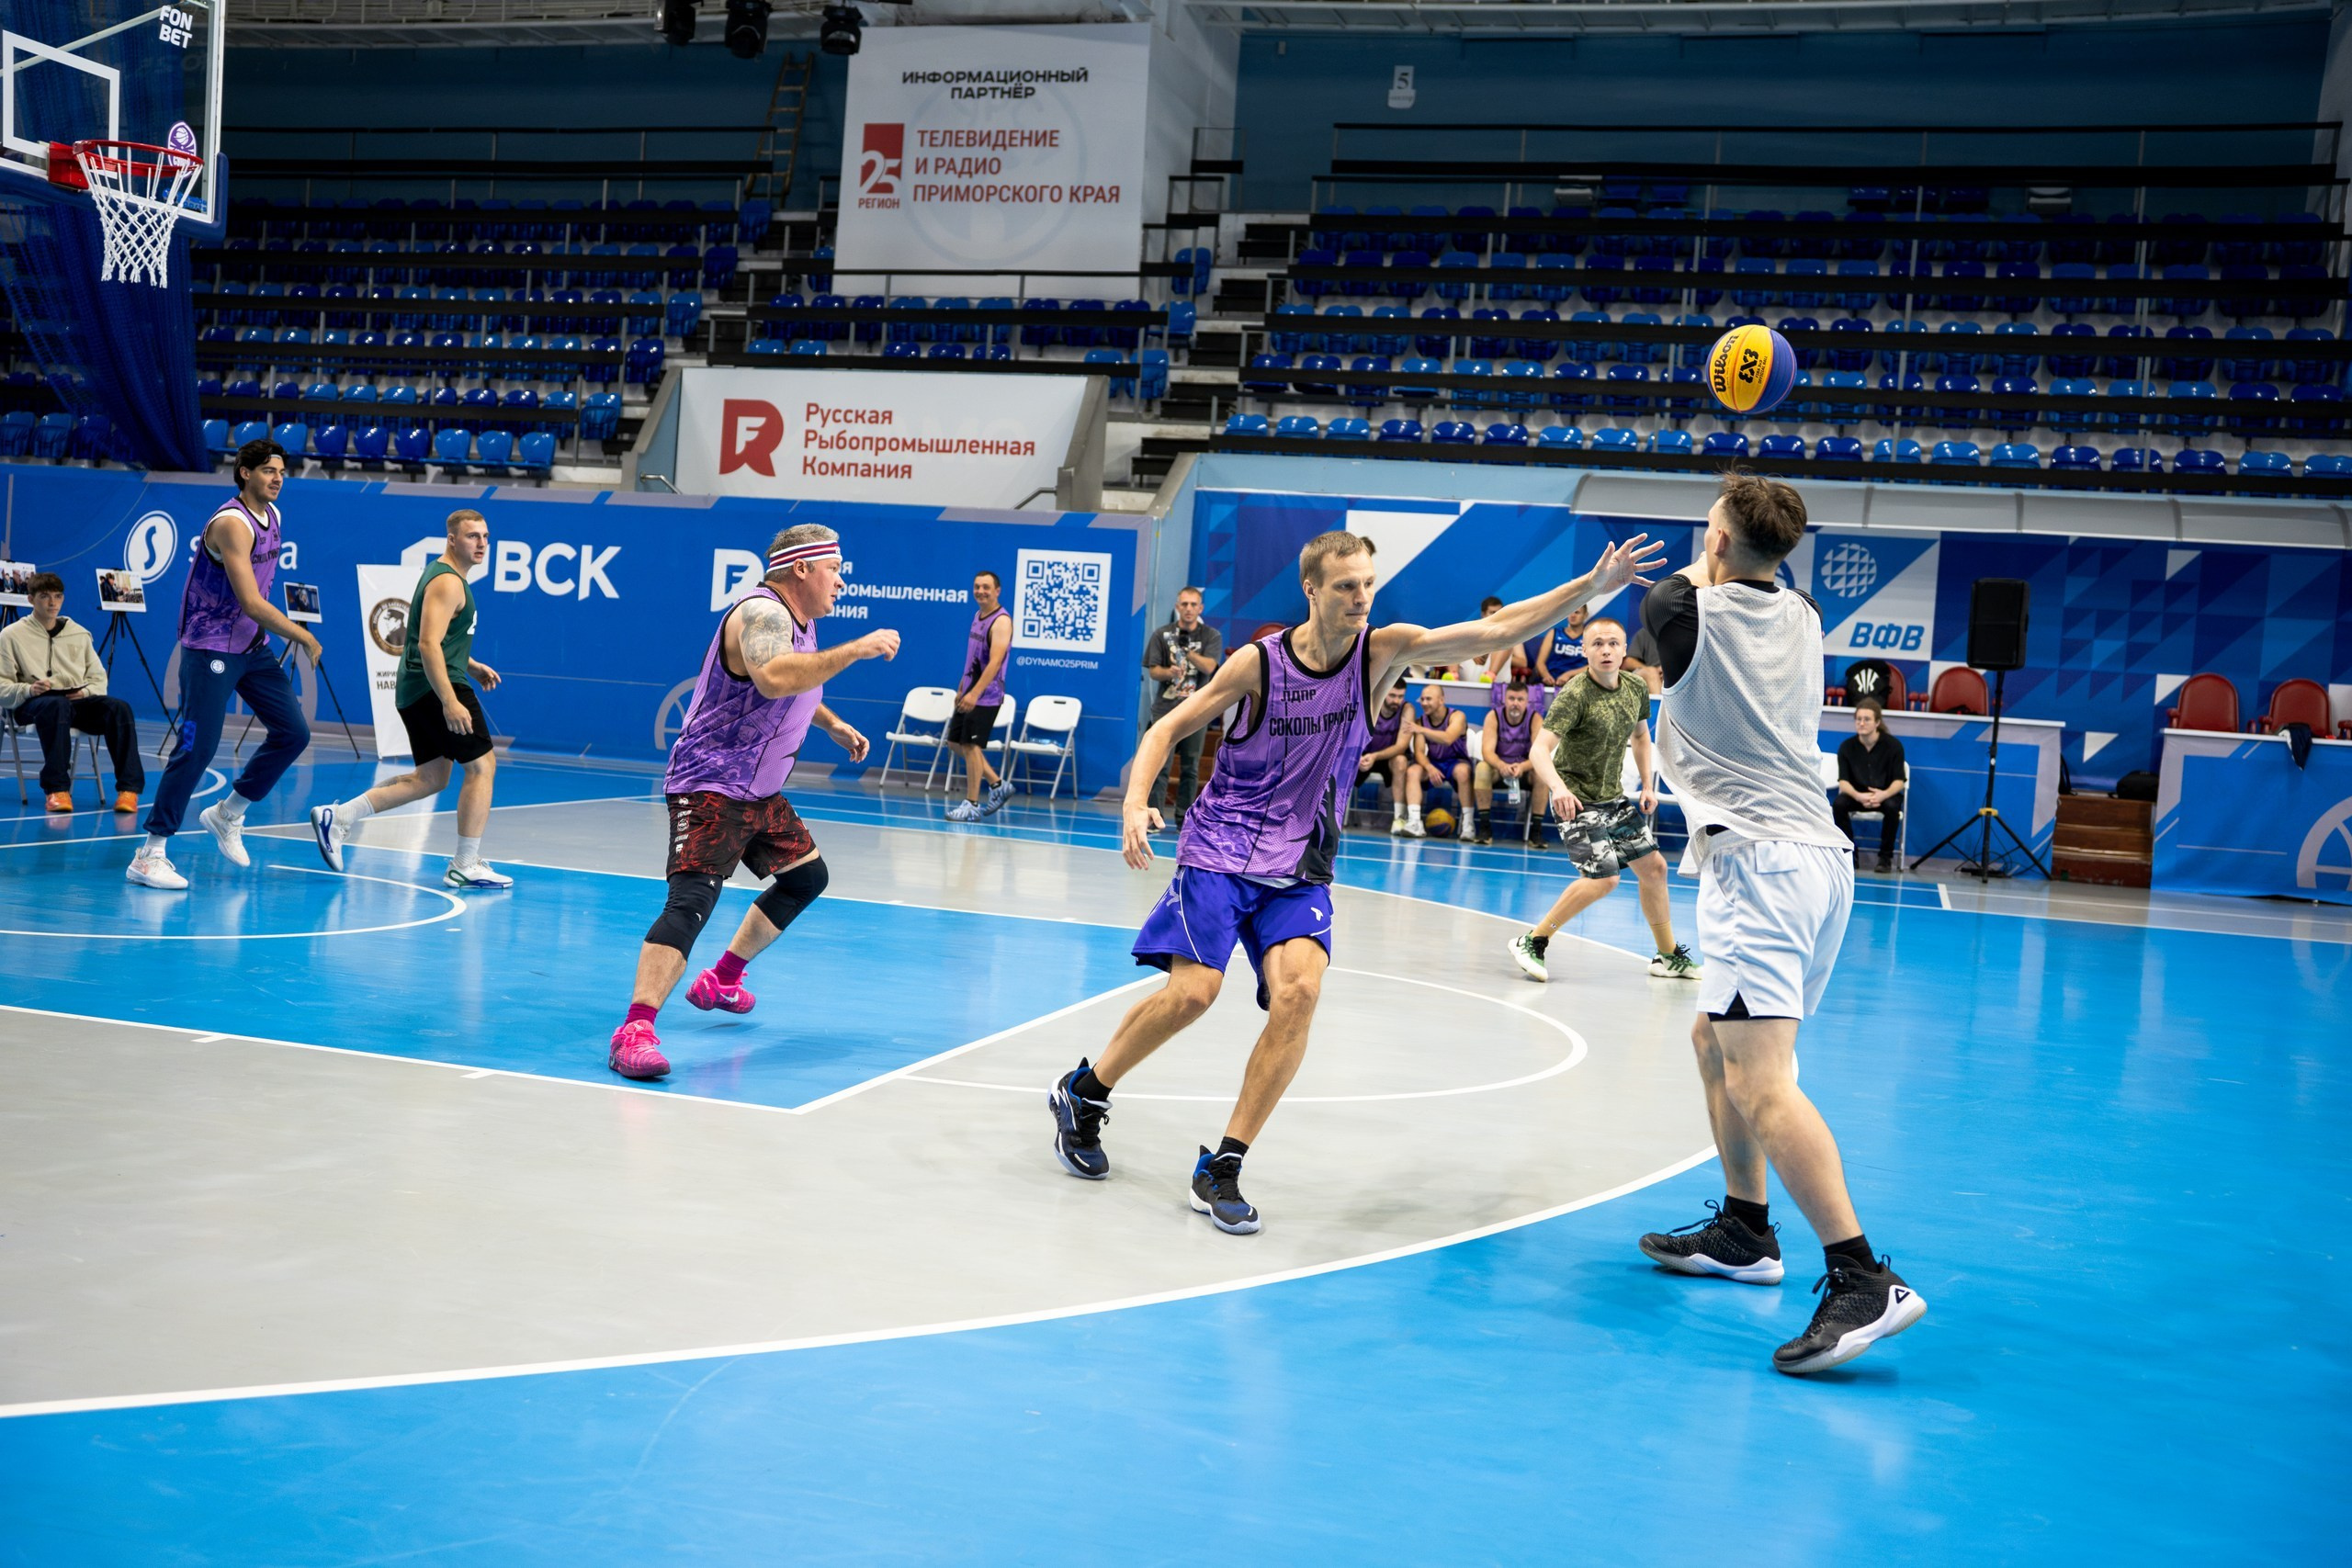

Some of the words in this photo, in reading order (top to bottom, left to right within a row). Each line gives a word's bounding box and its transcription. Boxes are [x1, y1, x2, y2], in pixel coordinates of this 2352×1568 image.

[160, 5, 193, 31] FON
[159, 23, 193, 49] BET
[902, 67, 1089, 85] ИНФОРМАЦИОННЫЙ
[1396, 73, 1409, 89] 5
[950, 83, 1036, 99] ПАРТНЁР
[917, 130, 1060, 151] ТЕЛЕВИДЕНИЕ
[859, 149, 902, 194] 25
[915, 157, 928, 175] И
[933, 157, 1001, 178] РАДИО
[858, 197, 900, 209] РЕГИОН
[912, 185, 1063, 204] ПРИМОРСКОГО
[1069, 186, 1121, 204] КРАЯ
[1713, 334, 1740, 393] Wilson
[805, 402, 893, 428] Русская
[804, 429, 1035, 456] Рыбопромышленная
[802, 456, 912, 479] Компания
[493, 540, 622, 601] ВСК
[837, 581, 968, 604] ромышленная
[1849, 622, 1925, 651] ВФВ
[1016, 656, 1099, 670] @DYNAMO25PRIM
[1281, 689, 1317, 703] ЛДПР
[1269, 715, 1321, 736] СОКОЛЫ
